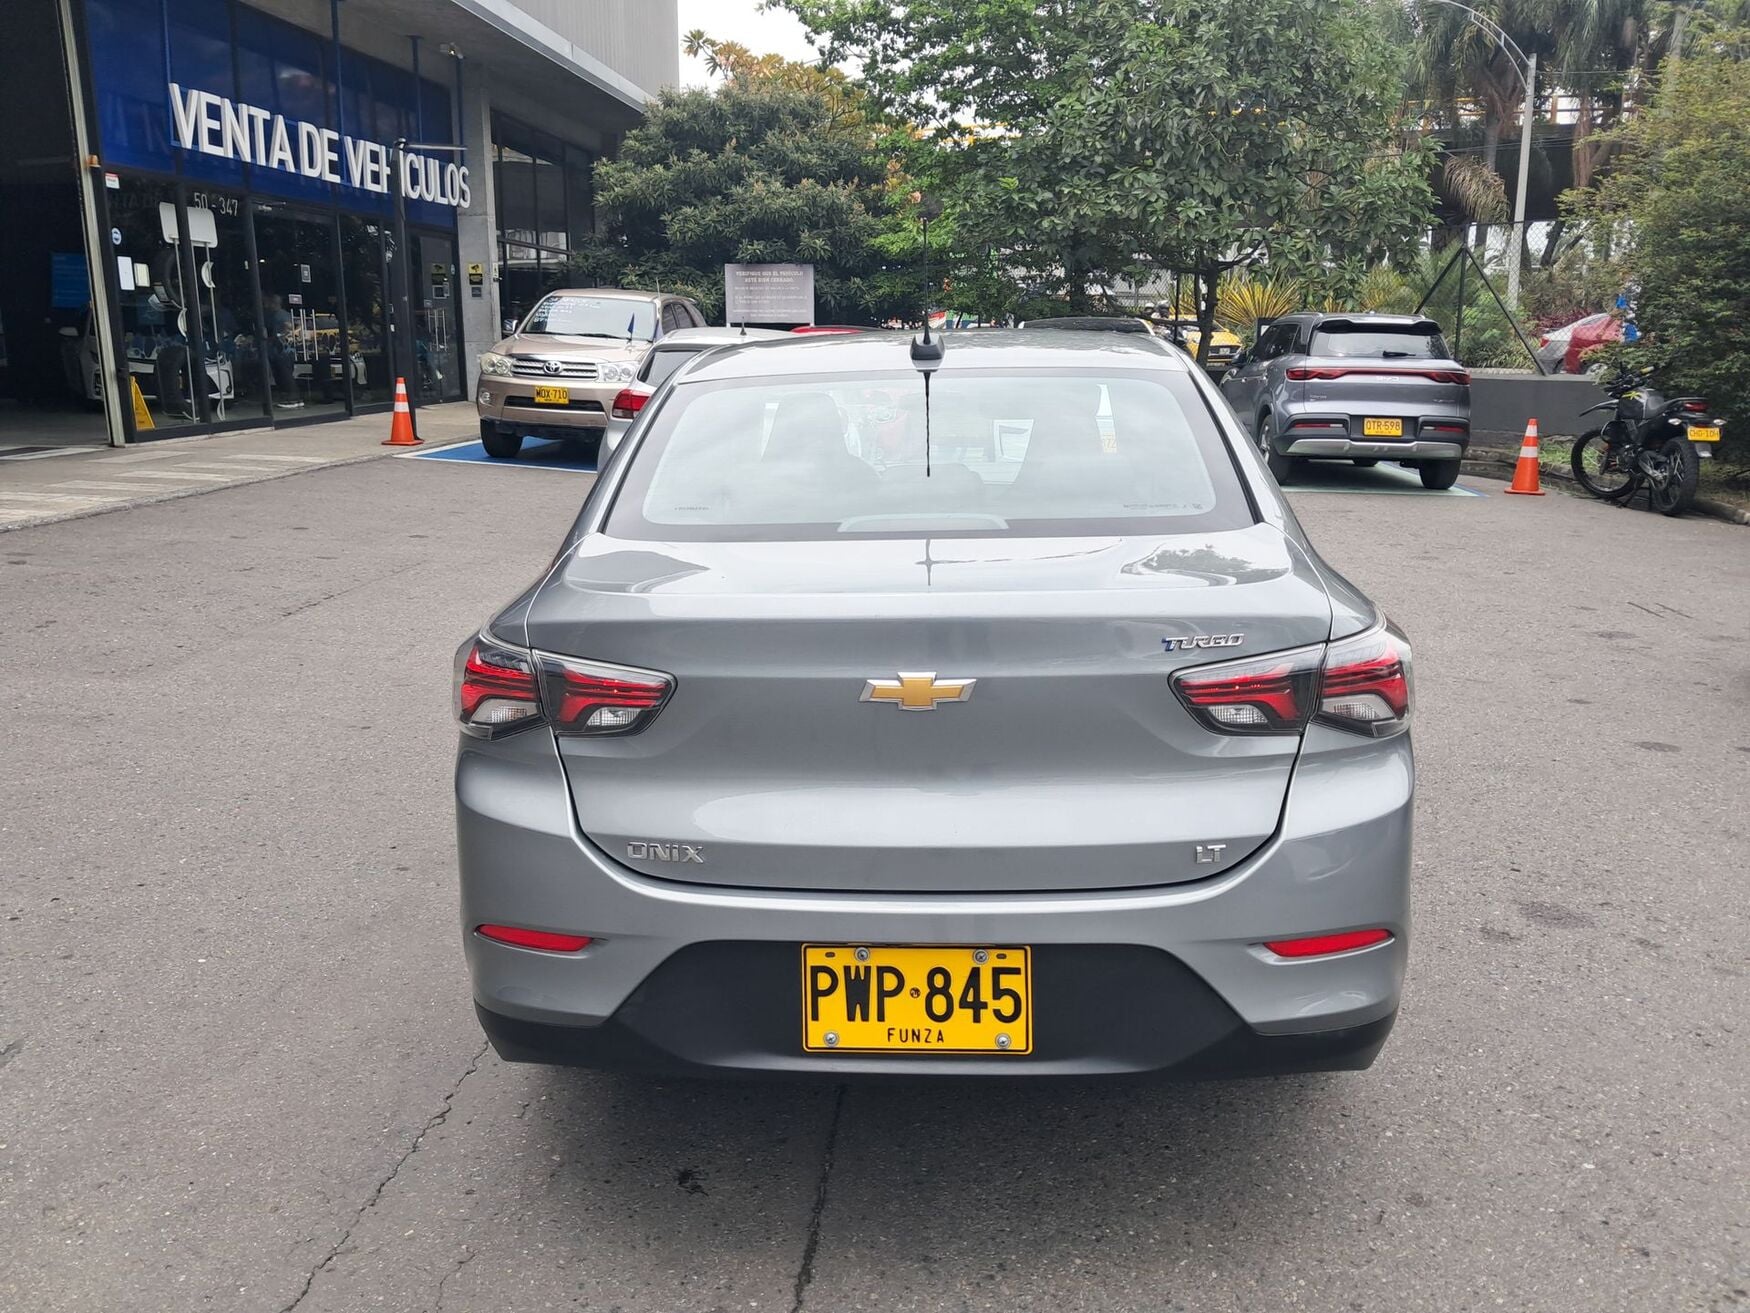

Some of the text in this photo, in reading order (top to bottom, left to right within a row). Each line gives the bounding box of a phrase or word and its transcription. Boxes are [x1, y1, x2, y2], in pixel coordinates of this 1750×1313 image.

[169, 83, 296, 173] VENTA
[298, 121, 341, 183] DE
[1162, 633, 1245, 651] TURBO
[627, 841, 704, 863] ONIX
[1196, 844, 1227, 864] LT
[887, 1027, 945, 1043] FUNZA
